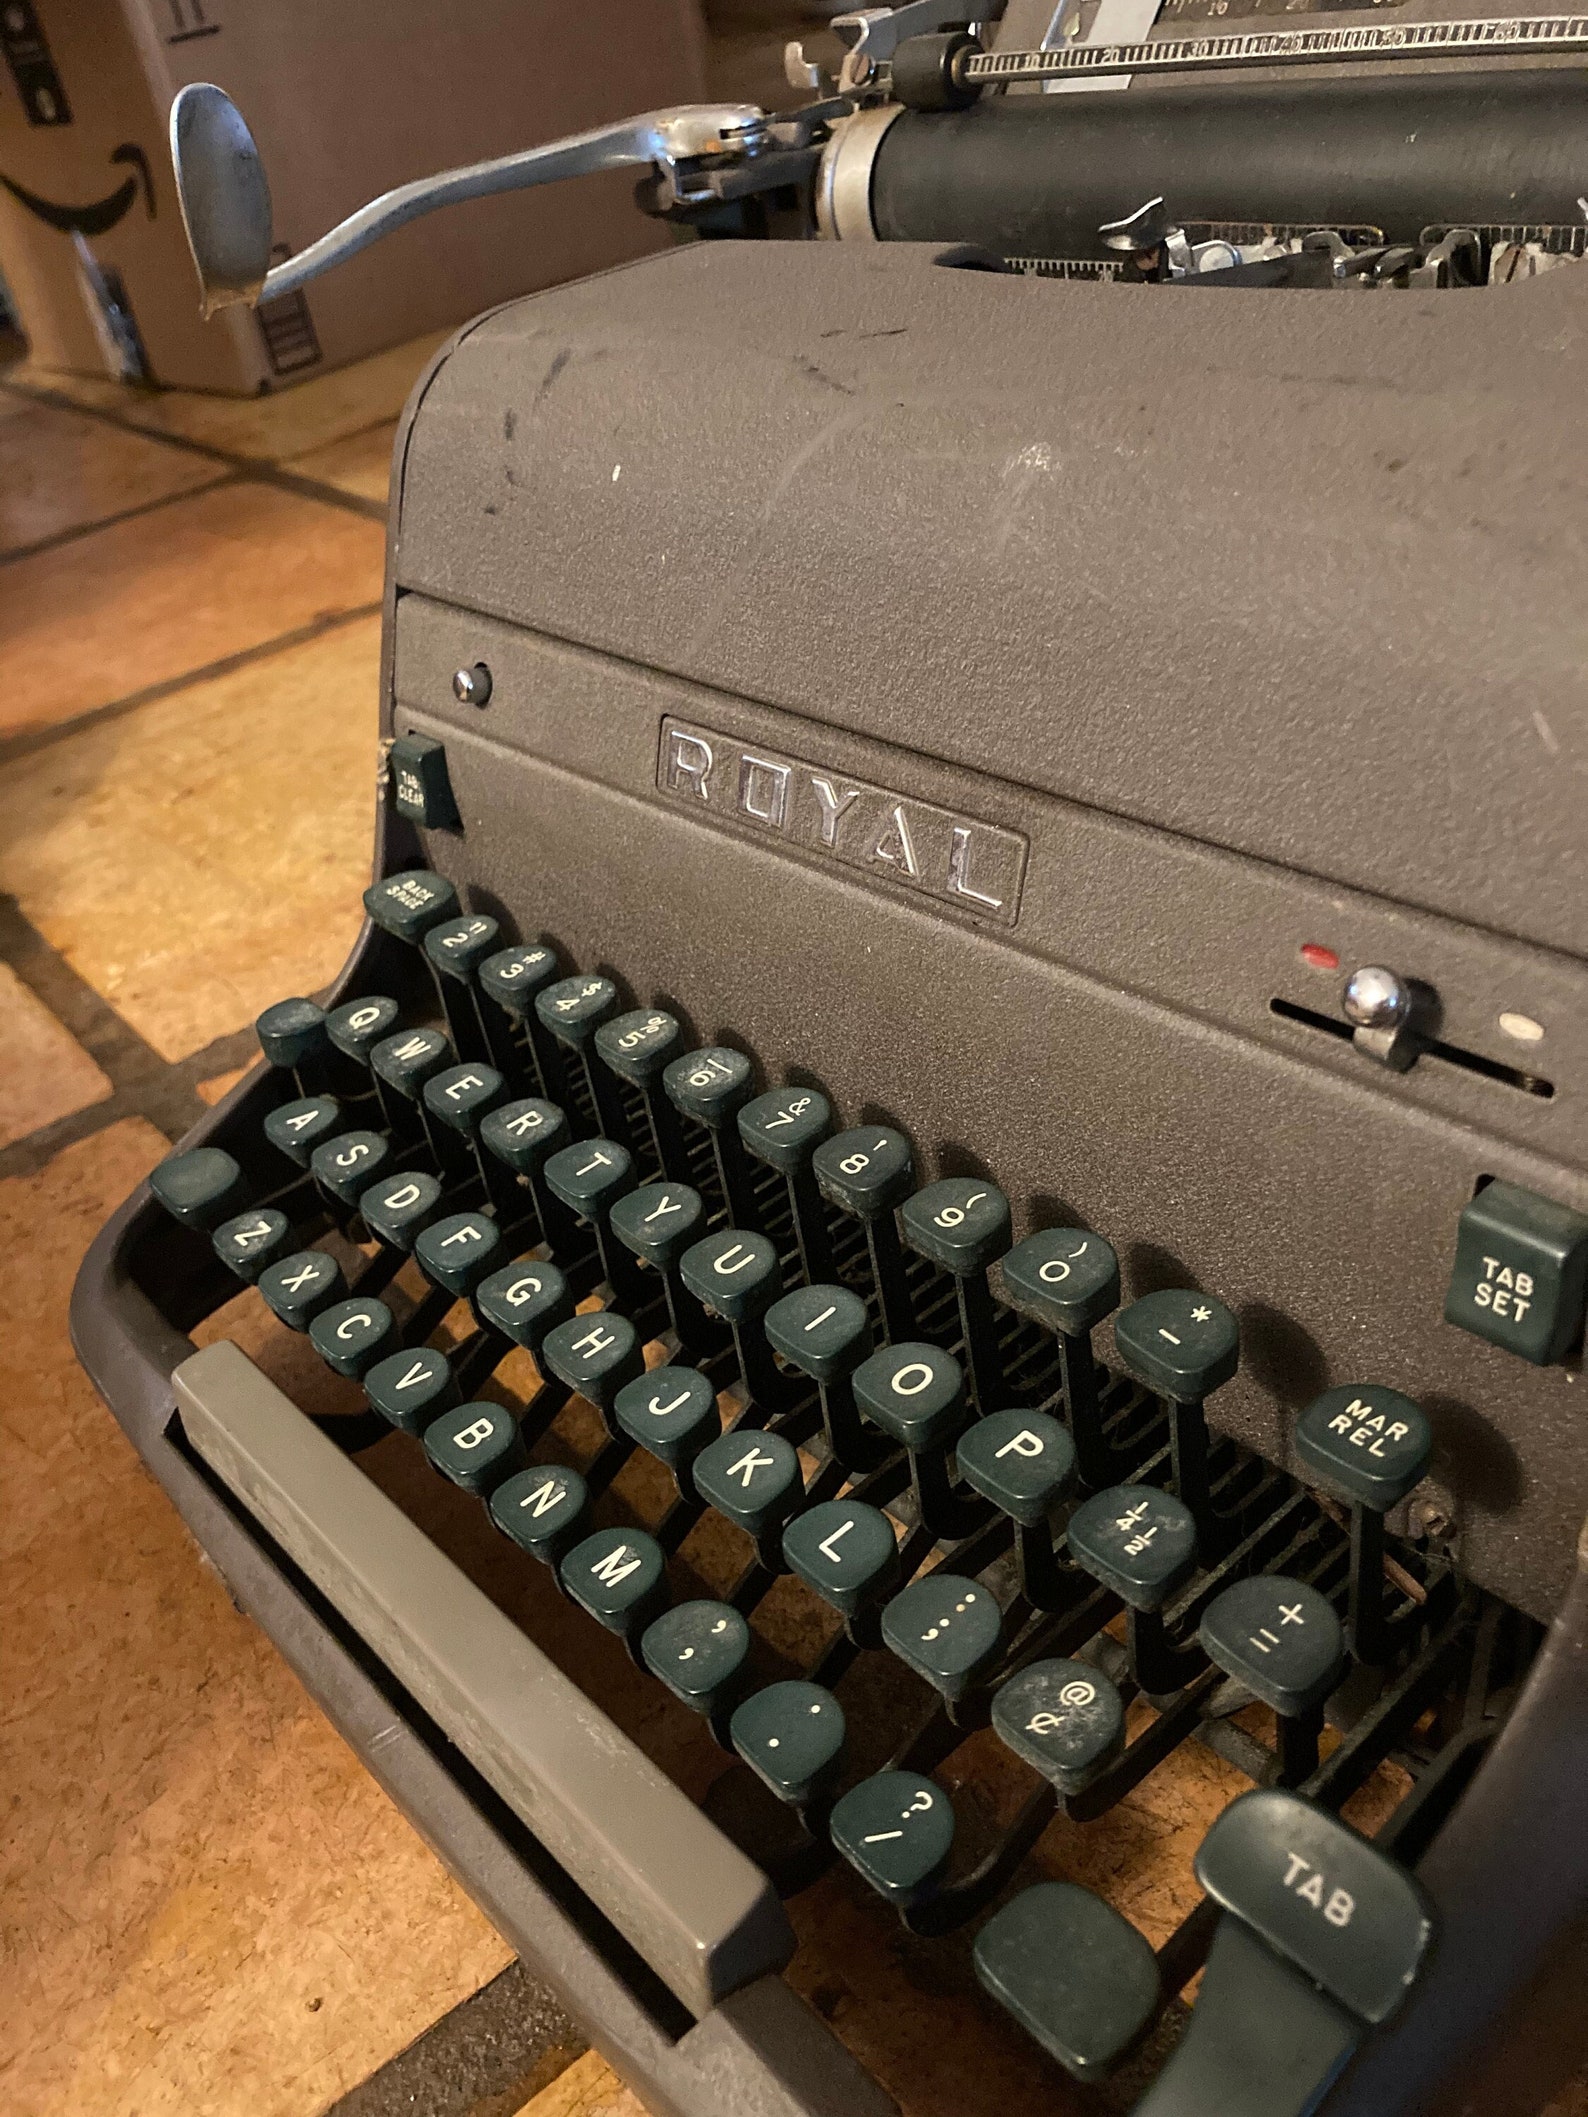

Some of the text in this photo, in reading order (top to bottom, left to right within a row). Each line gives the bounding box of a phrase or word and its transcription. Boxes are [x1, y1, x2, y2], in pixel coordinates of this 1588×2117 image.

[1025, 54, 1040, 69] 10
[1103, 48, 1119, 63] 20
[667, 729, 1004, 910] ROYAL
[386, 884, 425, 910] SPACE
[401, 879, 436, 902] BACK
[442, 932, 469, 948] 2
[499, 963, 525, 979] 3
[348, 1005, 381, 1031] Q
[555, 998, 581, 1012] 4
[393, 1036, 432, 1061] W
[618, 1030, 647, 1048] 5
[445, 1075, 484, 1100] E
[688, 1068, 717, 1088] 6
[286, 1110, 319, 1131] A
[506, 1110, 544, 1136] R
[764, 1110, 796, 1130] 7
[336, 1144, 370, 1166] S
[575, 1151, 612, 1176] T
[839, 1153, 870, 1175] 8
[383, 1184, 421, 1209] D
[644, 1195, 682, 1222] Y
[933, 1207, 965, 1228] 9
[233, 1220, 272, 1247] Z
[440, 1226, 482, 1247] F
[713, 1244, 756, 1275] U
[281, 1264, 320, 1293] X
[1481, 1254, 1535, 1298] TAB
[505, 1277, 542, 1307] G
[1473, 1281, 1533, 1323] SET
[336, 1314, 372, 1339] C
[571, 1326, 615, 1359] H
[395, 1361, 433, 1390] V
[891, 1363, 934, 1396] O
[648, 1391, 691, 1416] J
[452, 1417, 494, 1449] B
[1343, 1398, 1410, 1443] MAR
[994, 1430, 1044, 1458] P
[1327, 1413, 1387, 1459] REL
[726, 1447, 774, 1487] K
[519, 1480, 567, 1518] N
[818, 1520, 855, 1563] L
[590, 1545, 642, 1588] M
[1282, 1850, 1357, 1929] TAB
